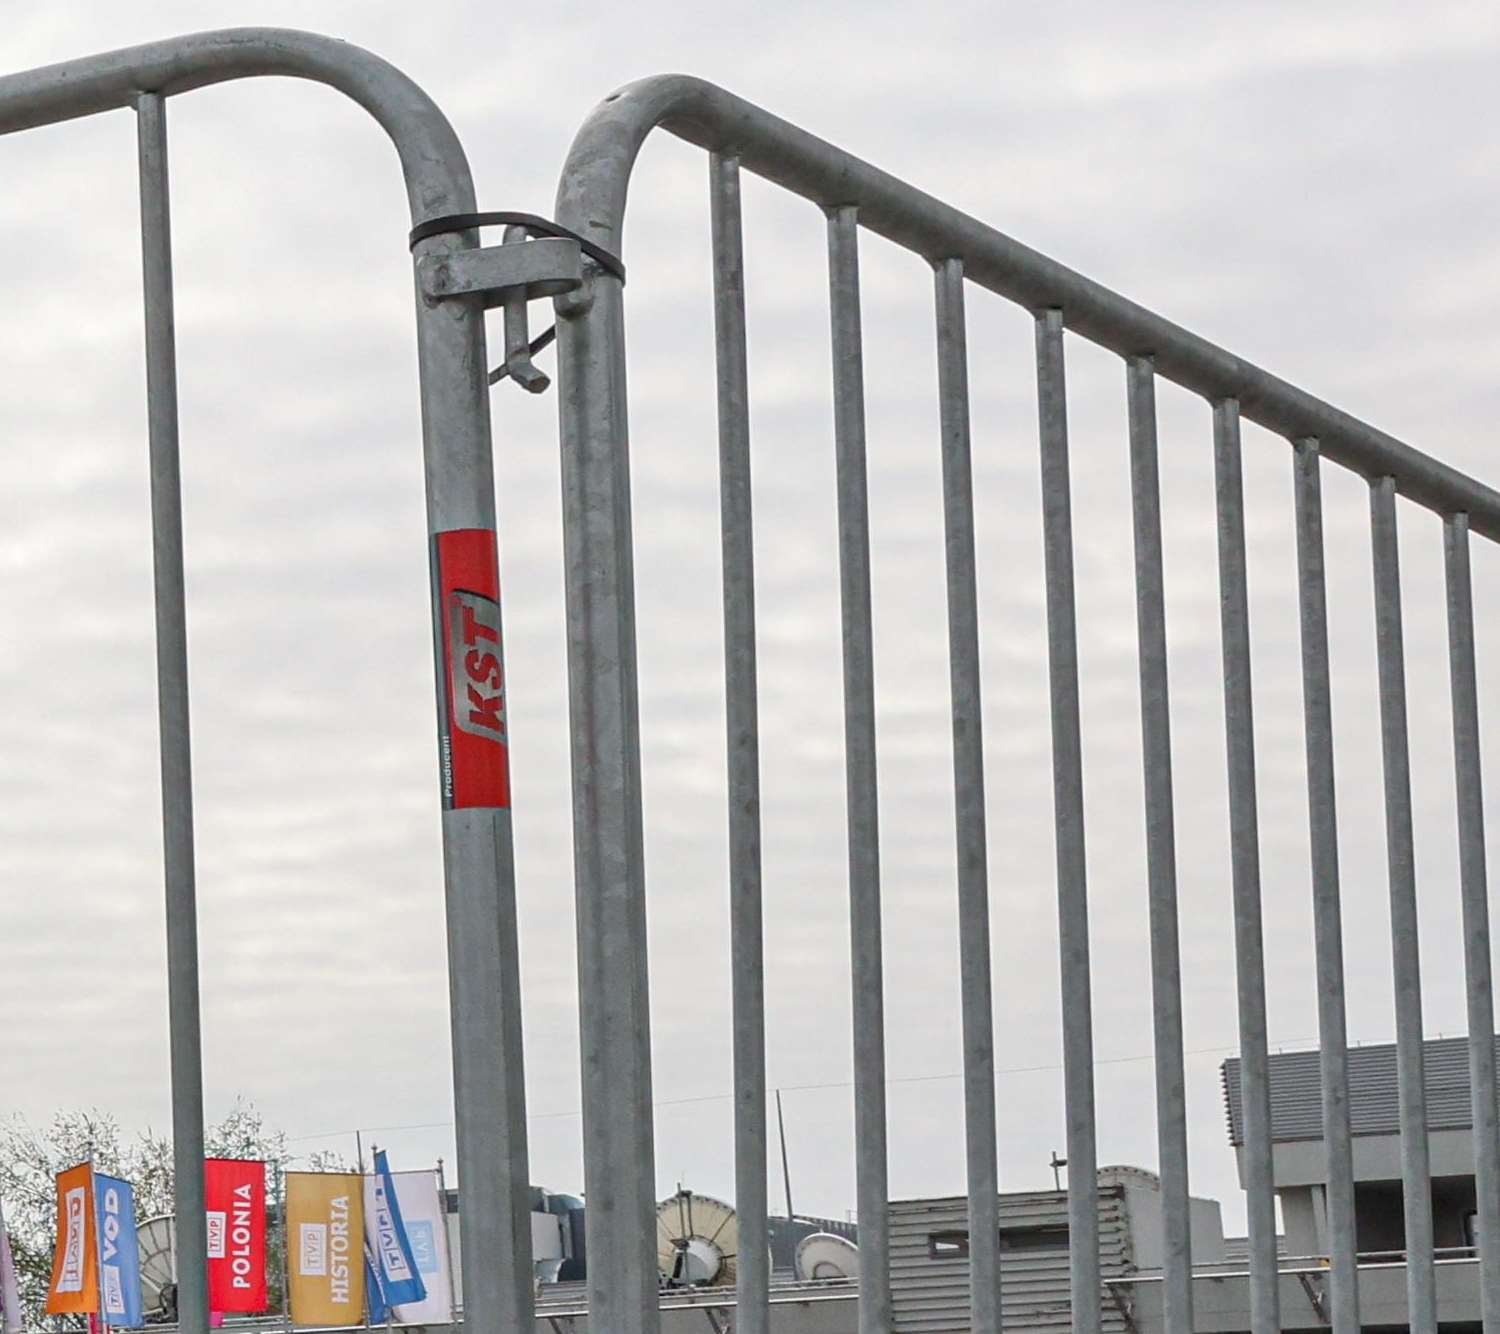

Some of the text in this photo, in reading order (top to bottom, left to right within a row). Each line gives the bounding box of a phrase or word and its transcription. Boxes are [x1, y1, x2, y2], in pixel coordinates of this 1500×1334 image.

[462, 605, 505, 735] KST
[443, 735, 453, 798] Producent
[103, 1188, 119, 1261] VOD
[209, 1220, 222, 1249] TVP
[232, 1184, 252, 1288] POLONIA
[307, 1233, 319, 1266] TVP
[331, 1195, 350, 1303] HISTORIA
